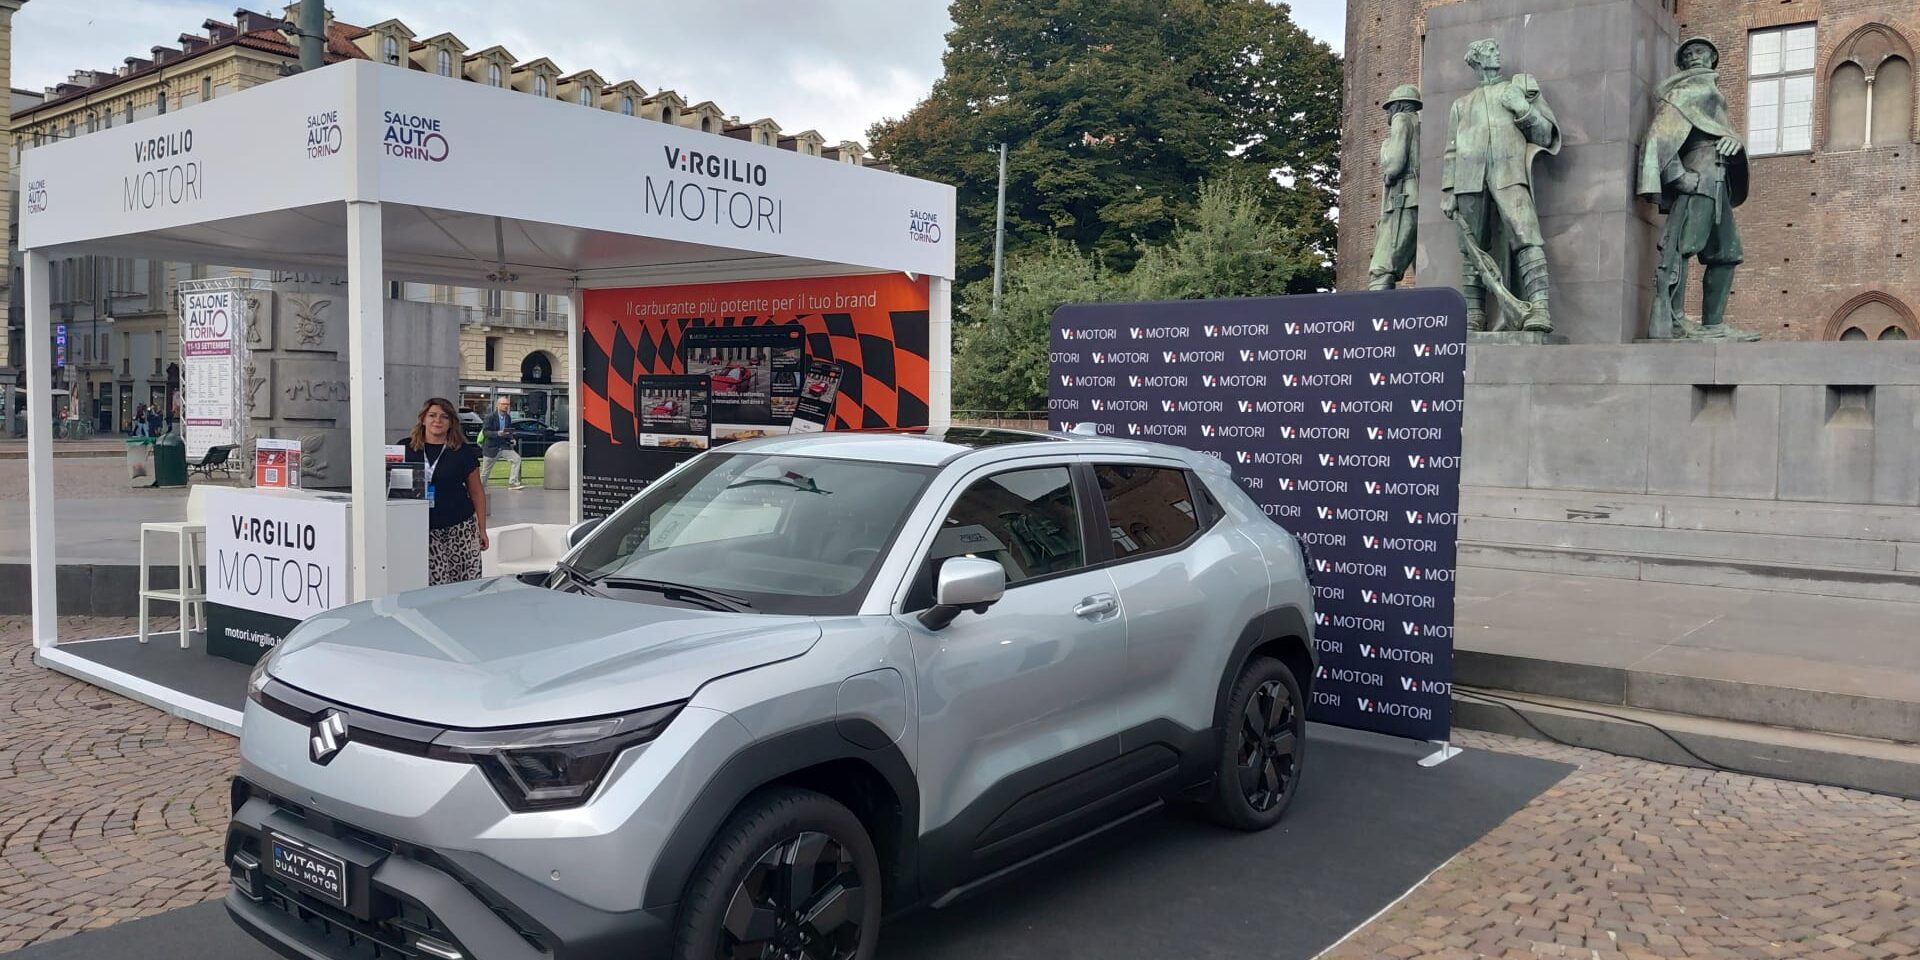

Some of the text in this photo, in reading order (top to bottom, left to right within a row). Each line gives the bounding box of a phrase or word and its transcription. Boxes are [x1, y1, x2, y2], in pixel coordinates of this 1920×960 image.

[308, 110, 338, 128] SALONE
[384, 111, 440, 132] SALONE
[124, 160, 202, 212] MOTORI
[646, 176, 782, 234] MOTORI
[910, 210, 937, 222] SALONE
[189, 294, 228, 309] SALONE
[635, 300, 696, 316] carburante
[700, 298, 717, 318] più
[720, 298, 768, 319] potente
[772, 298, 794, 316] per
[798, 294, 805, 309] il
[808, 295, 831, 309] tuo
[836, 291, 877, 308] brand
[1304, 320, 1355, 334] MOTORI
[1393, 315, 1448, 330] MOTORI
[1076, 329, 1116, 340] MOTORI
[1146, 327, 1190, 338] MOTORI
[1222, 324, 1269, 336] MOTORI
[1258, 349, 1306, 361] MOTORI
[1343, 346, 1395, 359] MOTORI
[1435, 343, 1466, 356] MOT
[1049, 353, 1080, 363] OTORI
[1108, 353, 1149, 363] MOTORI
[1180, 351, 1224, 362] MOTORI
[1076, 376, 1115, 386] MOTORI
[1145, 376, 1188, 387] MOTORI
[1220, 376, 1266, 386] MOTORI
[1302, 374, 1352, 386] MOTORI
[1390, 372, 1444, 384] MOTORI
[1107, 400, 1148, 411] MOTORI
[1178, 401, 1222, 412] MOTORI
[1256, 402, 1304, 412] MOTORI
[1341, 401, 1392, 412] MOTORI
[1432, 400, 1464, 412] MOT
[1098, 424, 1114, 434] ORI
[1144, 425, 1186, 435] MOTORI
[1219, 426, 1264, 437] MOTORI
[1300, 428, 1350, 439] MOTORI
[1387, 428, 1441, 440] MOTORI
[1254, 453, 1302, 464] MOTORI
[1338, 455, 1390, 467] MOTORI
[1429, 456, 1461, 468] MOT
[1242, 477, 1263, 488] ORI
[1298, 480, 1348, 492] MOTORI
[1385, 483, 1439, 496] MOTORI
[1261, 504, 1300, 517] OTORI
[1337, 509, 1388, 522] MOTORI
[1427, 513, 1457, 525] MOT
[1383, 538, 1436, 552] MOTORI
[1335, 562, 1386, 576] MOTORI
[1425, 568, 1456, 581] MOT
[219, 549, 330, 609] MOTORI
[1382, 593, 1435, 608] MOTORI
[1333, 615, 1384, 632] MOTORI
[1424, 624, 1454, 638] MOT
[1315, 639, 1343, 653] TORI
[1380, 647, 1433, 664] MOTORI
[1332, 668, 1383, 686] MOTORI
[1422, 681, 1452, 695] MOT
[1313, 692, 1340, 706] TORI
[1378, 702, 1432, 720] MOTORI
[276, 860, 338, 892] DUAL MOTOR
